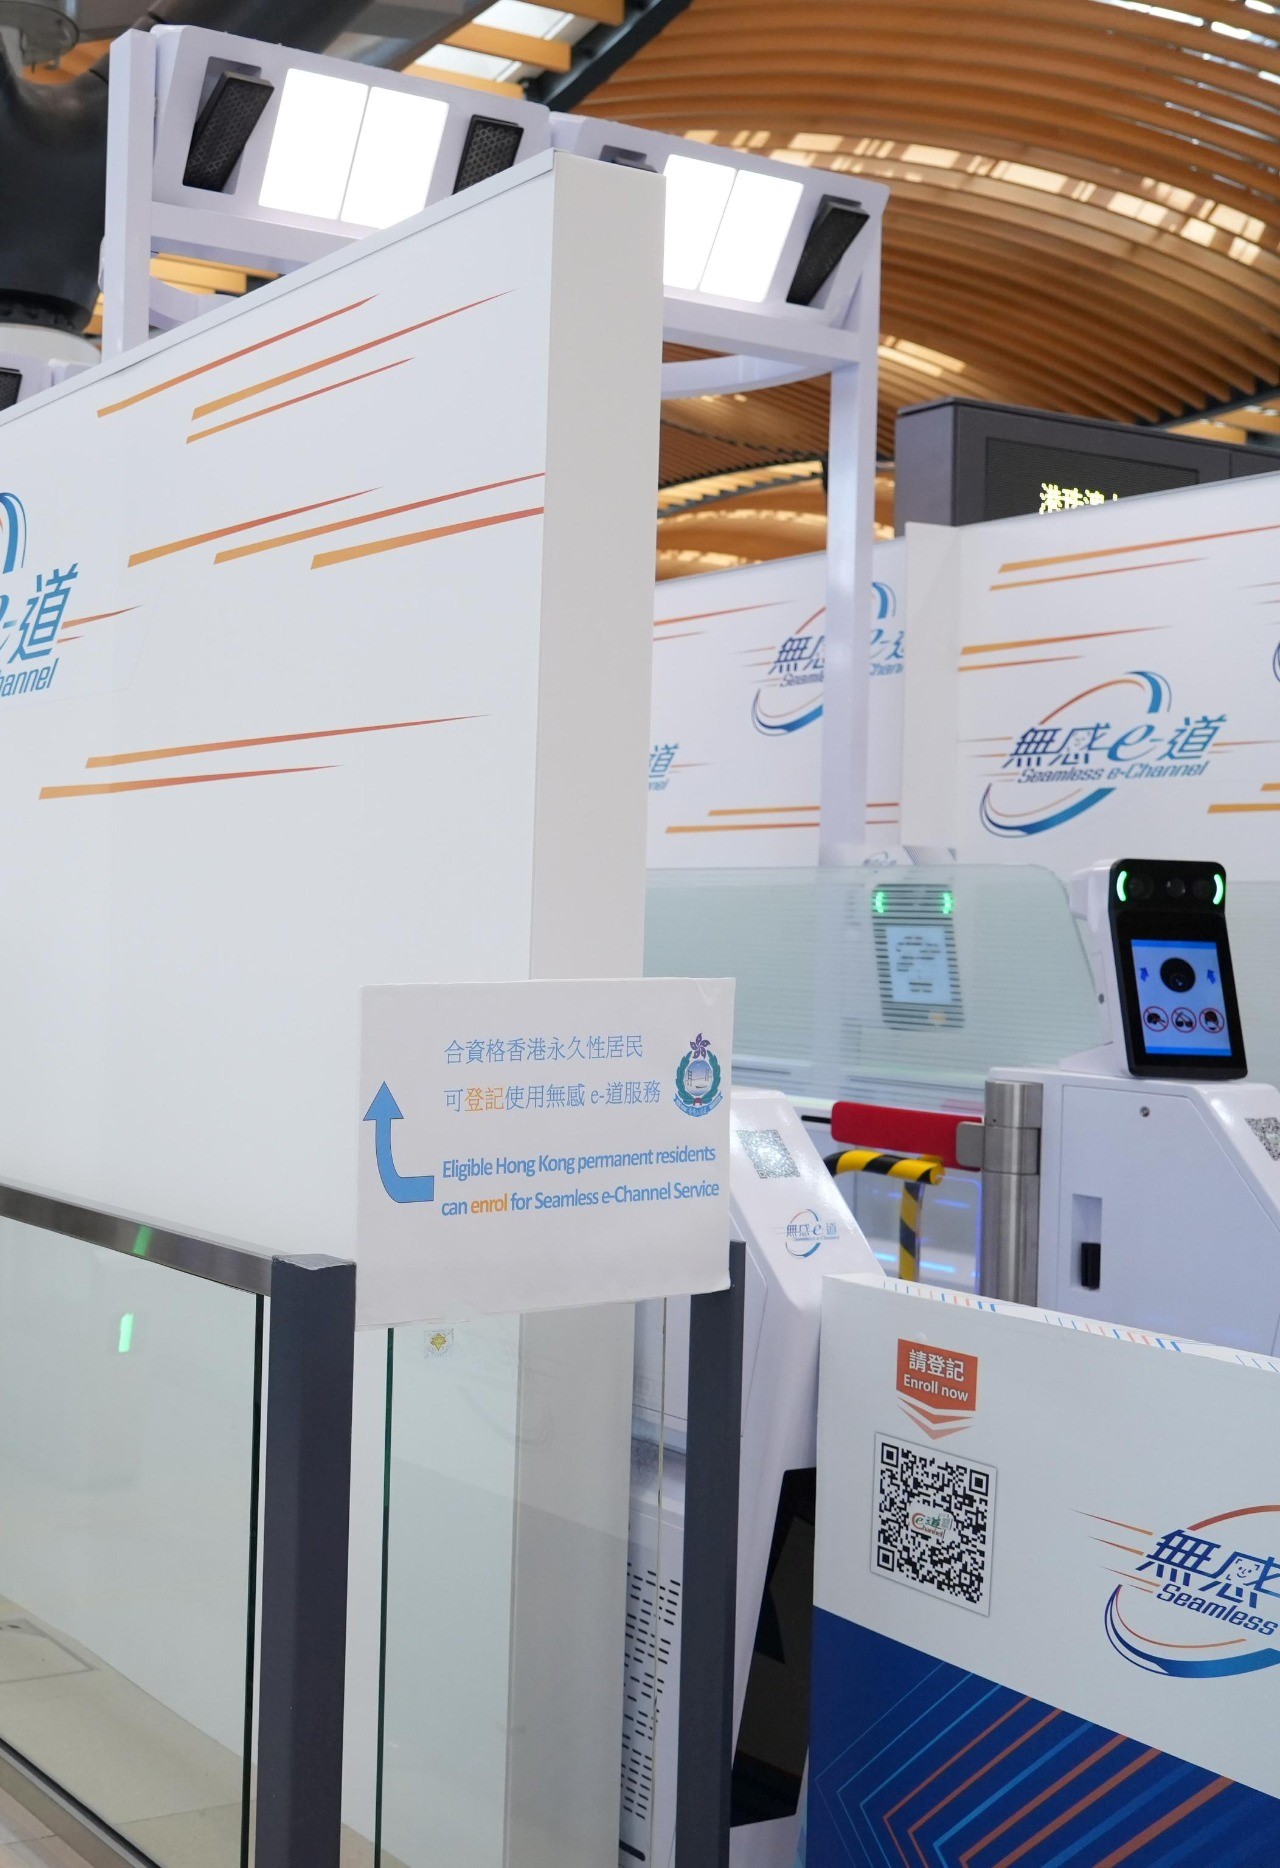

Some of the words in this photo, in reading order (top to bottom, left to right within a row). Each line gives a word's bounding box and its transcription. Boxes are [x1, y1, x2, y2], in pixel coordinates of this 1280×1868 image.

[1017, 766, 1105, 784] Seamless
[1107, 760, 1210, 780] e-Channel
[444, 1035, 643, 1064] 合資格香港永久性居民
[442, 1157, 493, 1181] Eligible
[496, 1157, 536, 1177] Hong
[538, 1155, 575, 1175] Kong
[577, 1149, 653, 1174] permanent
[656, 1145, 716, 1164] residents
[441, 1201, 468, 1216] can
[470, 1193, 508, 1214] enrol
[510, 1192, 533, 1211] for
[534, 1188, 599, 1209] Seamless
[601, 1182, 670, 1204] e-Channel
[674, 1180, 720, 1199] Service
[909, 1349, 965, 1382] 請登記
[903, 1373, 939, 1395] Enroll
[941, 1386, 969, 1402] now
[1156, 1583, 1279, 1636] Seamless
